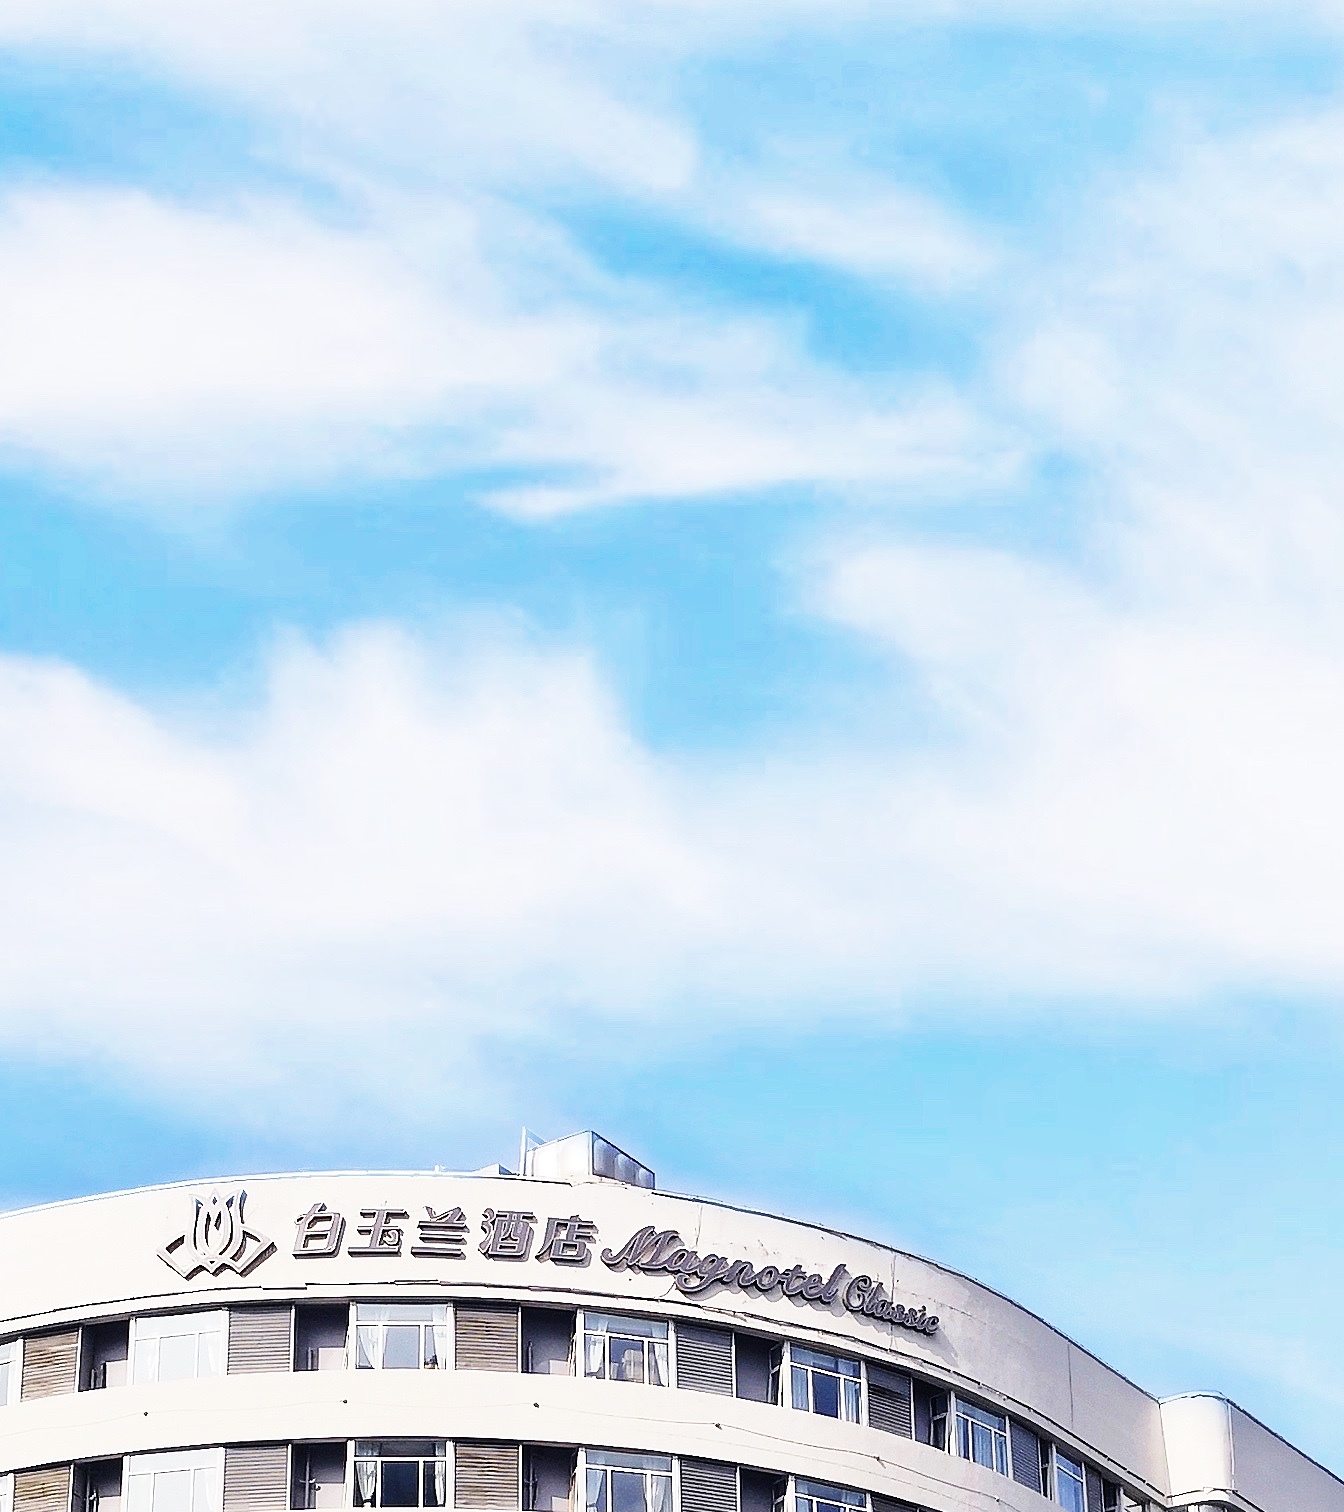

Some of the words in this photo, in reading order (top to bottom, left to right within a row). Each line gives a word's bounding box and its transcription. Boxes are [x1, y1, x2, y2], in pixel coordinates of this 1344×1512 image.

[293, 1202, 598, 1265] 白玉兰酒店
[600, 1225, 848, 1303] Magnotel
[843, 1268, 940, 1334] Classic
